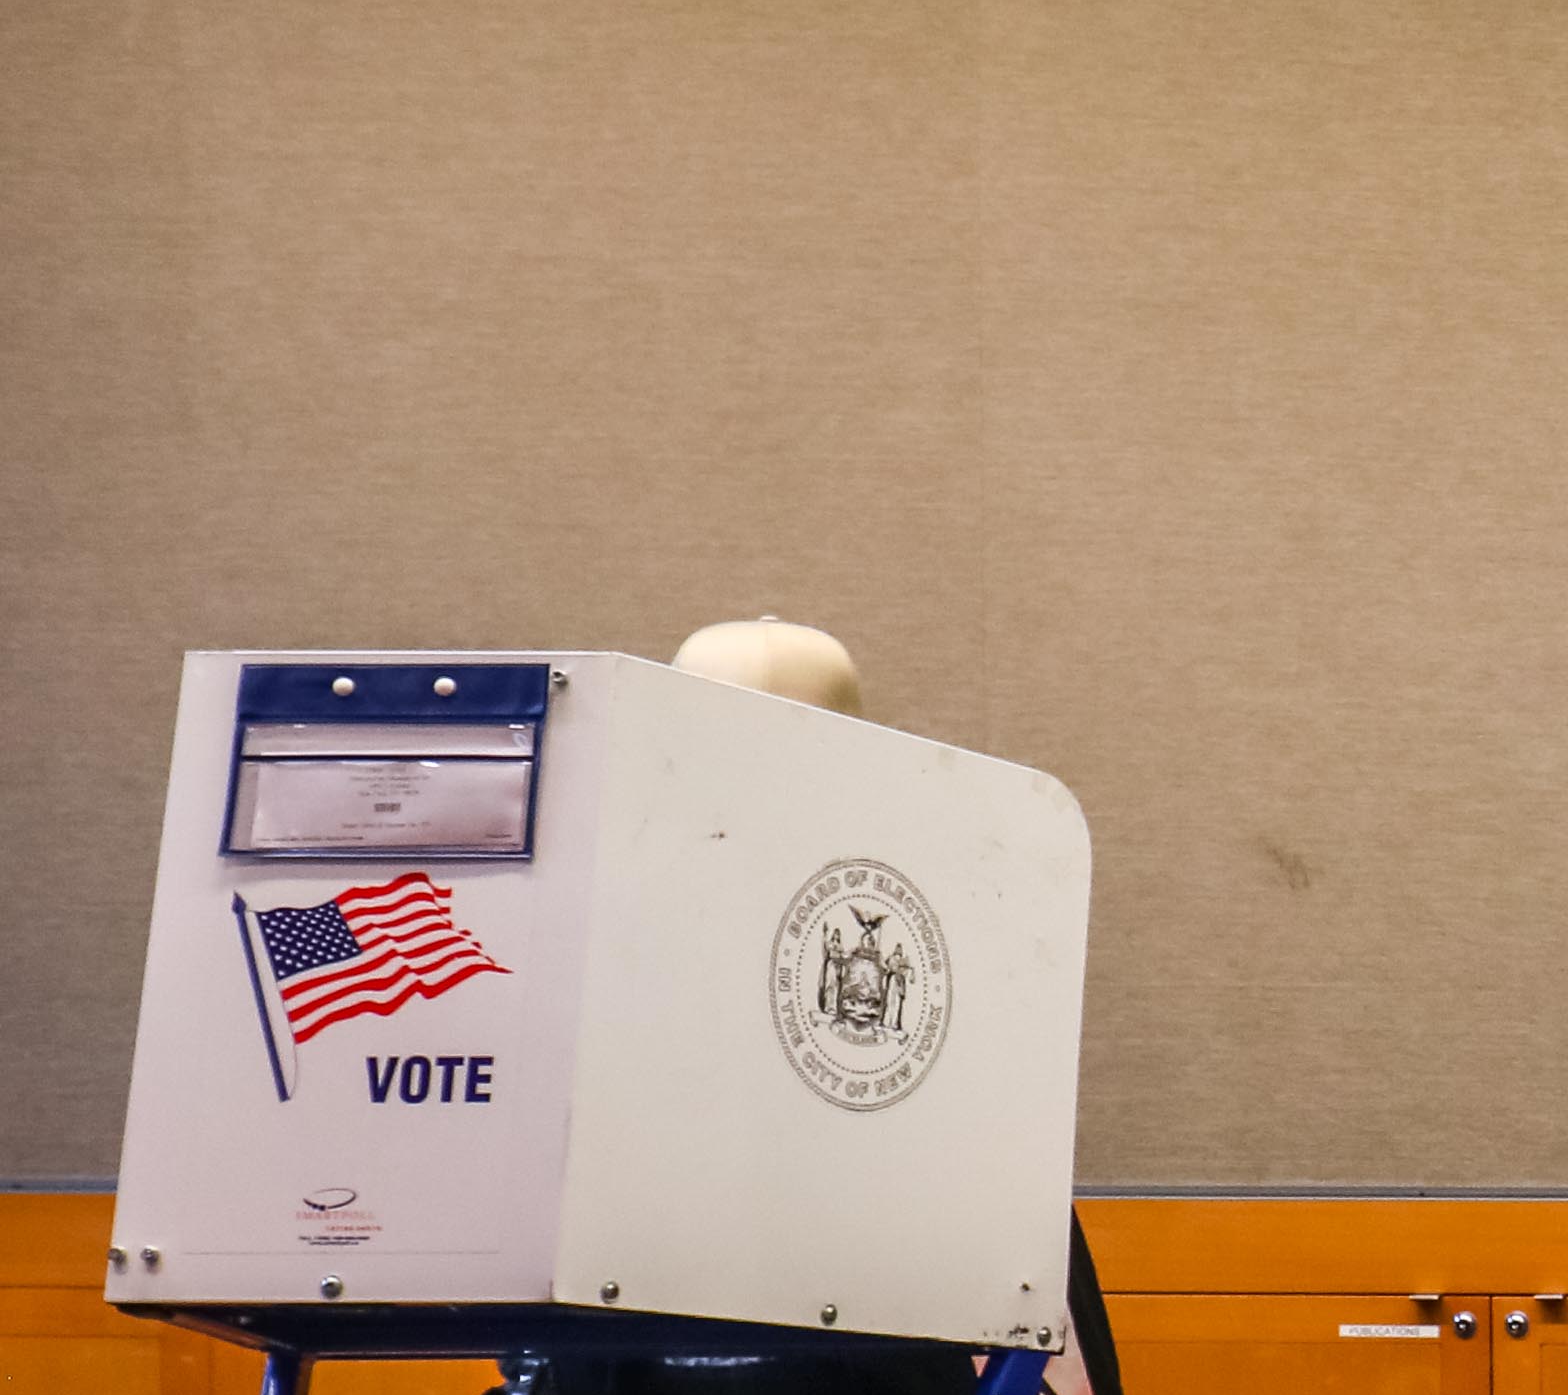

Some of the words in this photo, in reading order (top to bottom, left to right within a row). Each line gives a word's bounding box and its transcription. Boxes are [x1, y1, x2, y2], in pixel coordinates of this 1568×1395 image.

[788, 877, 840, 939] BOARD
[845, 870, 868, 888] OF
[874, 874, 943, 974] ELECTIONS
[778, 967, 792, 991] IN
[781, 1000, 804, 1048] THE
[913, 1004, 943, 1061] YORK
[366, 1056, 494, 1103] VOTE
[803, 1052, 842, 1091] CITY
[846, 1081, 869, 1098] OF
[875, 1061, 912, 1096] NEW
